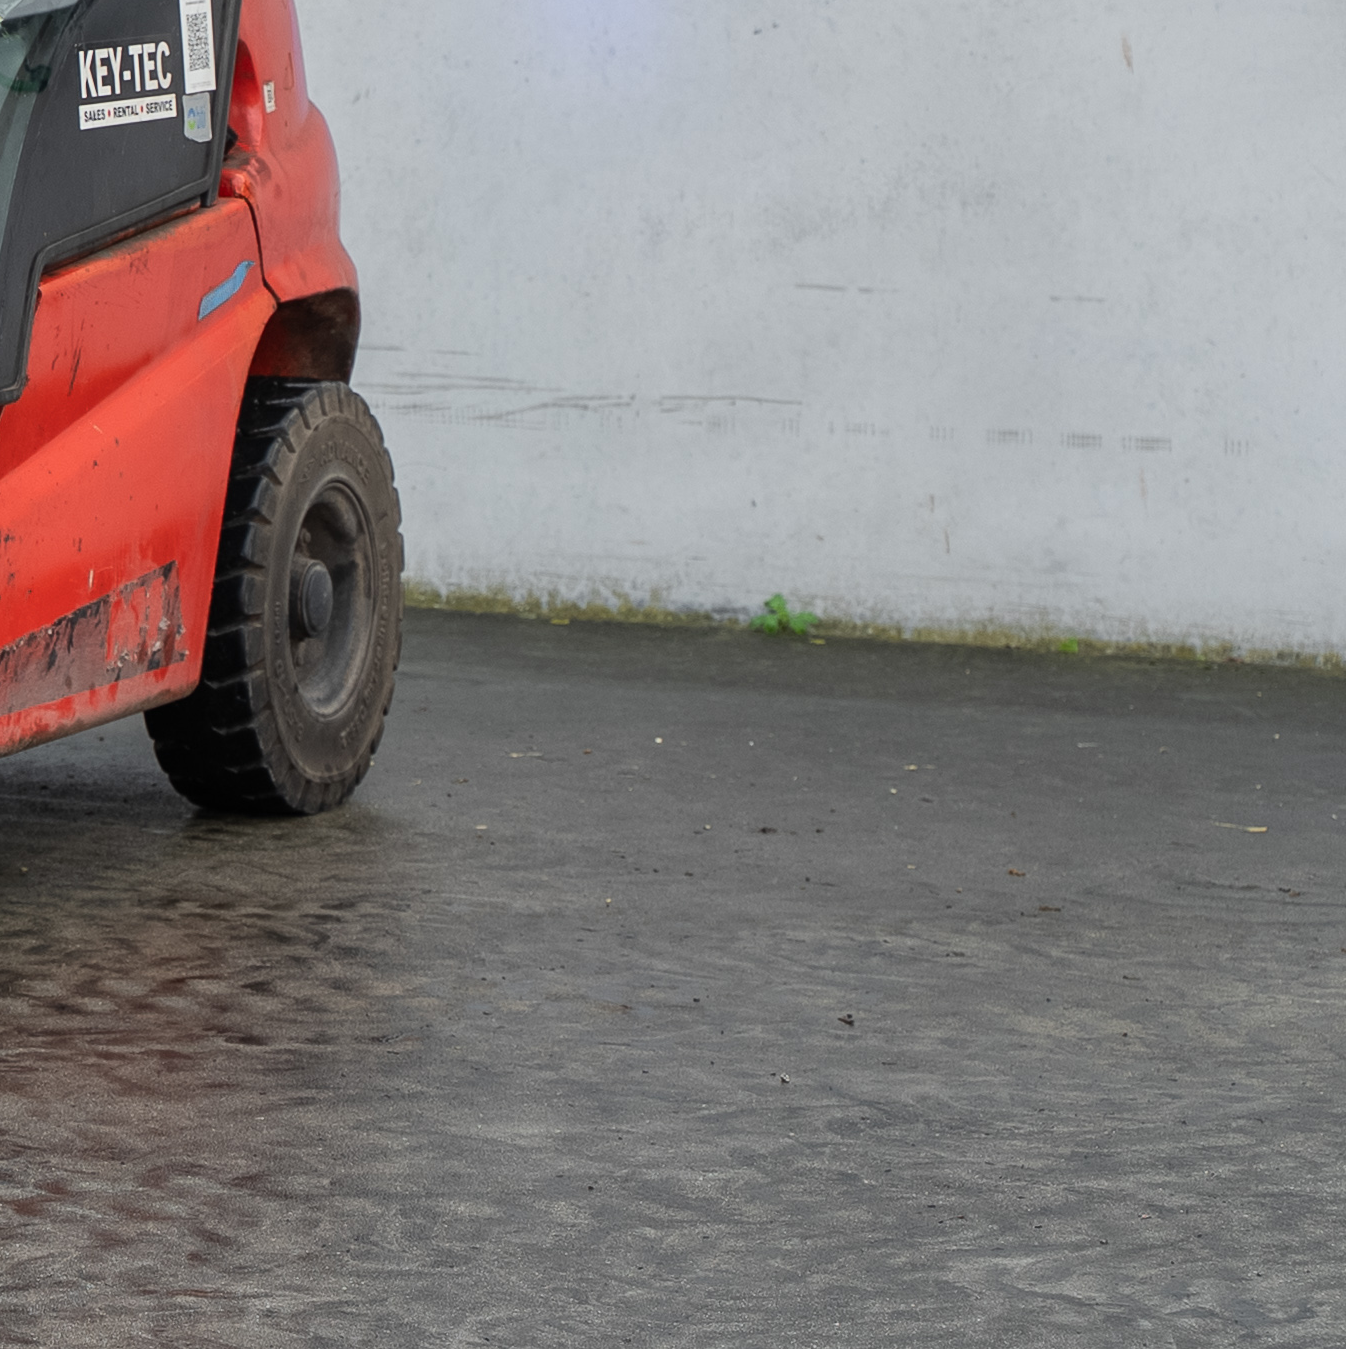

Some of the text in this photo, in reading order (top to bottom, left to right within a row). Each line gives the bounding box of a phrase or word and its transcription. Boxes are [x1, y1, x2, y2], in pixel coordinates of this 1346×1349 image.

[79, 41, 172, 99] KEY-TEC
[84, 100, 173, 122] SALES RENTAL SERVICE
